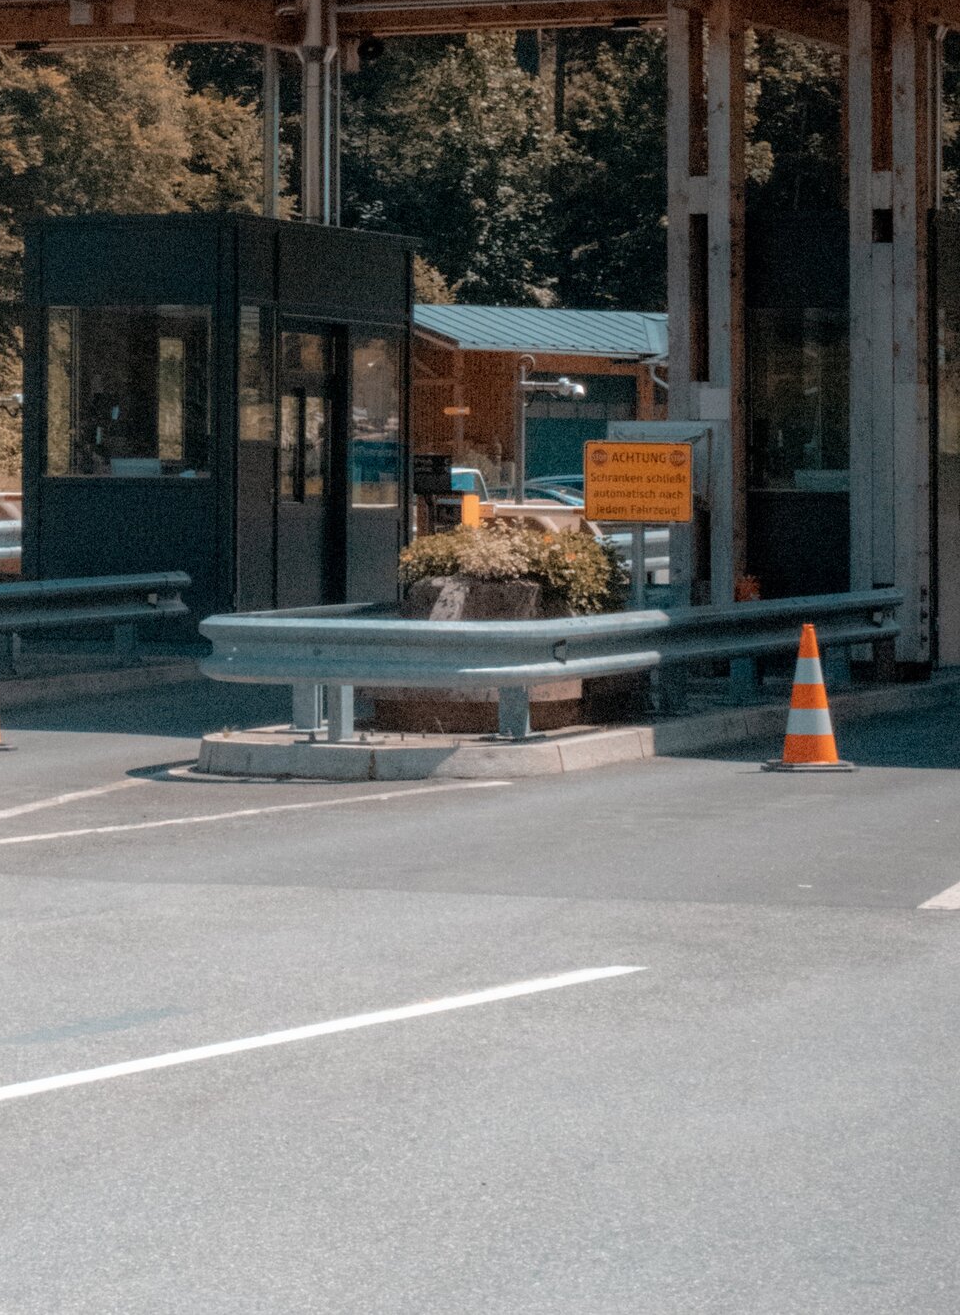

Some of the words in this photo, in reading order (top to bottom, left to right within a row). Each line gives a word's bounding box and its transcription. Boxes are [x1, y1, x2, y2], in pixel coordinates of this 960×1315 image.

[612, 452, 667, 463] ACHTUNG
[591, 473, 643, 483] Schranken
[647, 473, 686, 483] schließt
[594, 489, 656, 499] automatisch
[660, 490, 684, 499] nach
[596, 505, 627, 515] jedem
[630, 505, 680, 516] Fahrzeug!
